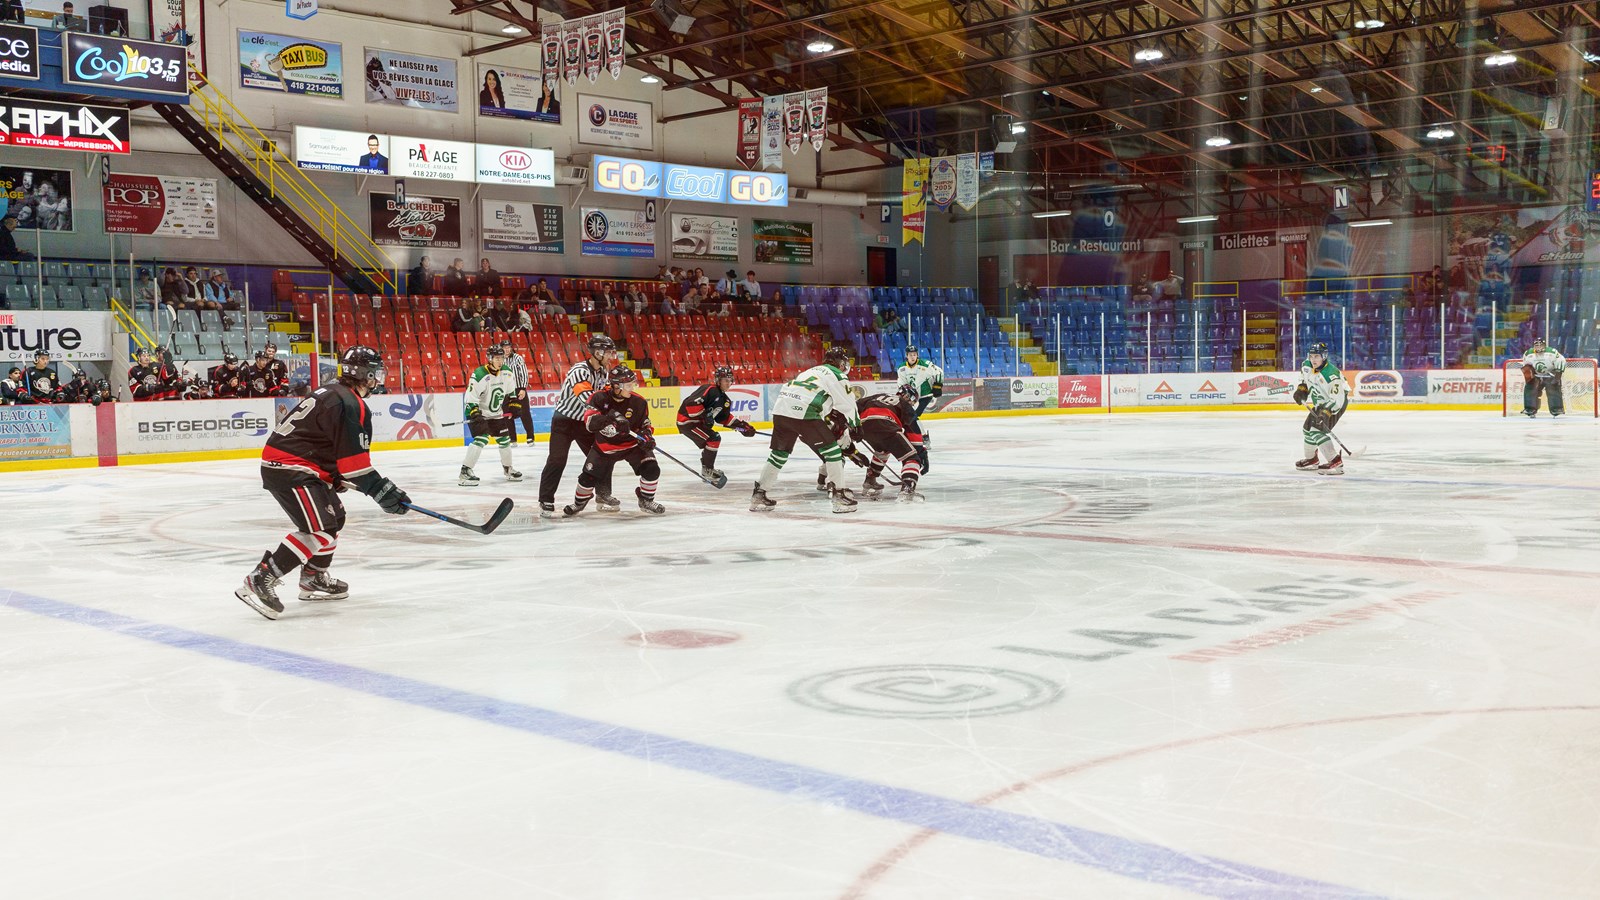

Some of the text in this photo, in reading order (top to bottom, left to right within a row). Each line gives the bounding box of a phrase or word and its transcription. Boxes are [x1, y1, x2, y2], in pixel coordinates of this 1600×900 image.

[251, 36, 264, 45] clé
[282, 50, 324, 65] TAXI BUS
[0, 60, 30, 72] édia
[389, 59, 438, 72] NE LAISSEZ PAS
[373, 71, 386, 80] VOS
[389, 73, 410, 82] RÊVES
[411, 76, 423, 84] SUR
[434, 79, 454, 88] GLACE
[291, 82, 304, 90] 418
[306, 83, 340, 94] 221-0066
[608, 110, 638, 120] LA CAGE
[16, 137, 114, 151] LETTRAGE-IMPRESSION
[309, 142, 330, 150] Samuel
[505, 154, 527, 166] KIA
[746, 151, 755, 159] CC
[102, 157, 109, 184] S
[322, 163, 342, 171] PRÉSENT
[426, 171, 454, 179] 227-0803
[479, 169, 552, 181] NOTRE-DAME-DES-PINS
[597, 160, 646, 191] GO
[109, 181, 159, 190] CHAUSSURES
[666, 168, 724, 200] Cool
[730, 175, 772, 202] GO
[107, 187, 159, 205] POP
[397, 183, 404, 203] R
[1335, 188, 1347, 207] N
[388, 201, 444, 212] BOUCHERIE
[646, 202, 655, 220] Q
[882, 204, 890, 221] P
[630, 222, 652, 230] EXPRESS
[1220, 233, 1269, 249] Toilettes
[1281, 234, 1307, 242] HOMMES
[1050, 238, 1141, 253] Bar Restaurant
[1183, 241, 1205, 249] FEMMES
[1540, 252, 1584, 262] ski-doo
[343, 365, 349, 373] 12
[1071, 380, 1087, 392] Tim
[1442, 382, 1494, 393] CENTRE
[1062, 392, 1097, 404] Hortons
[152, 418, 268, 433] ST-GEORGES
[1145, 574, 1416, 626] CAGE
